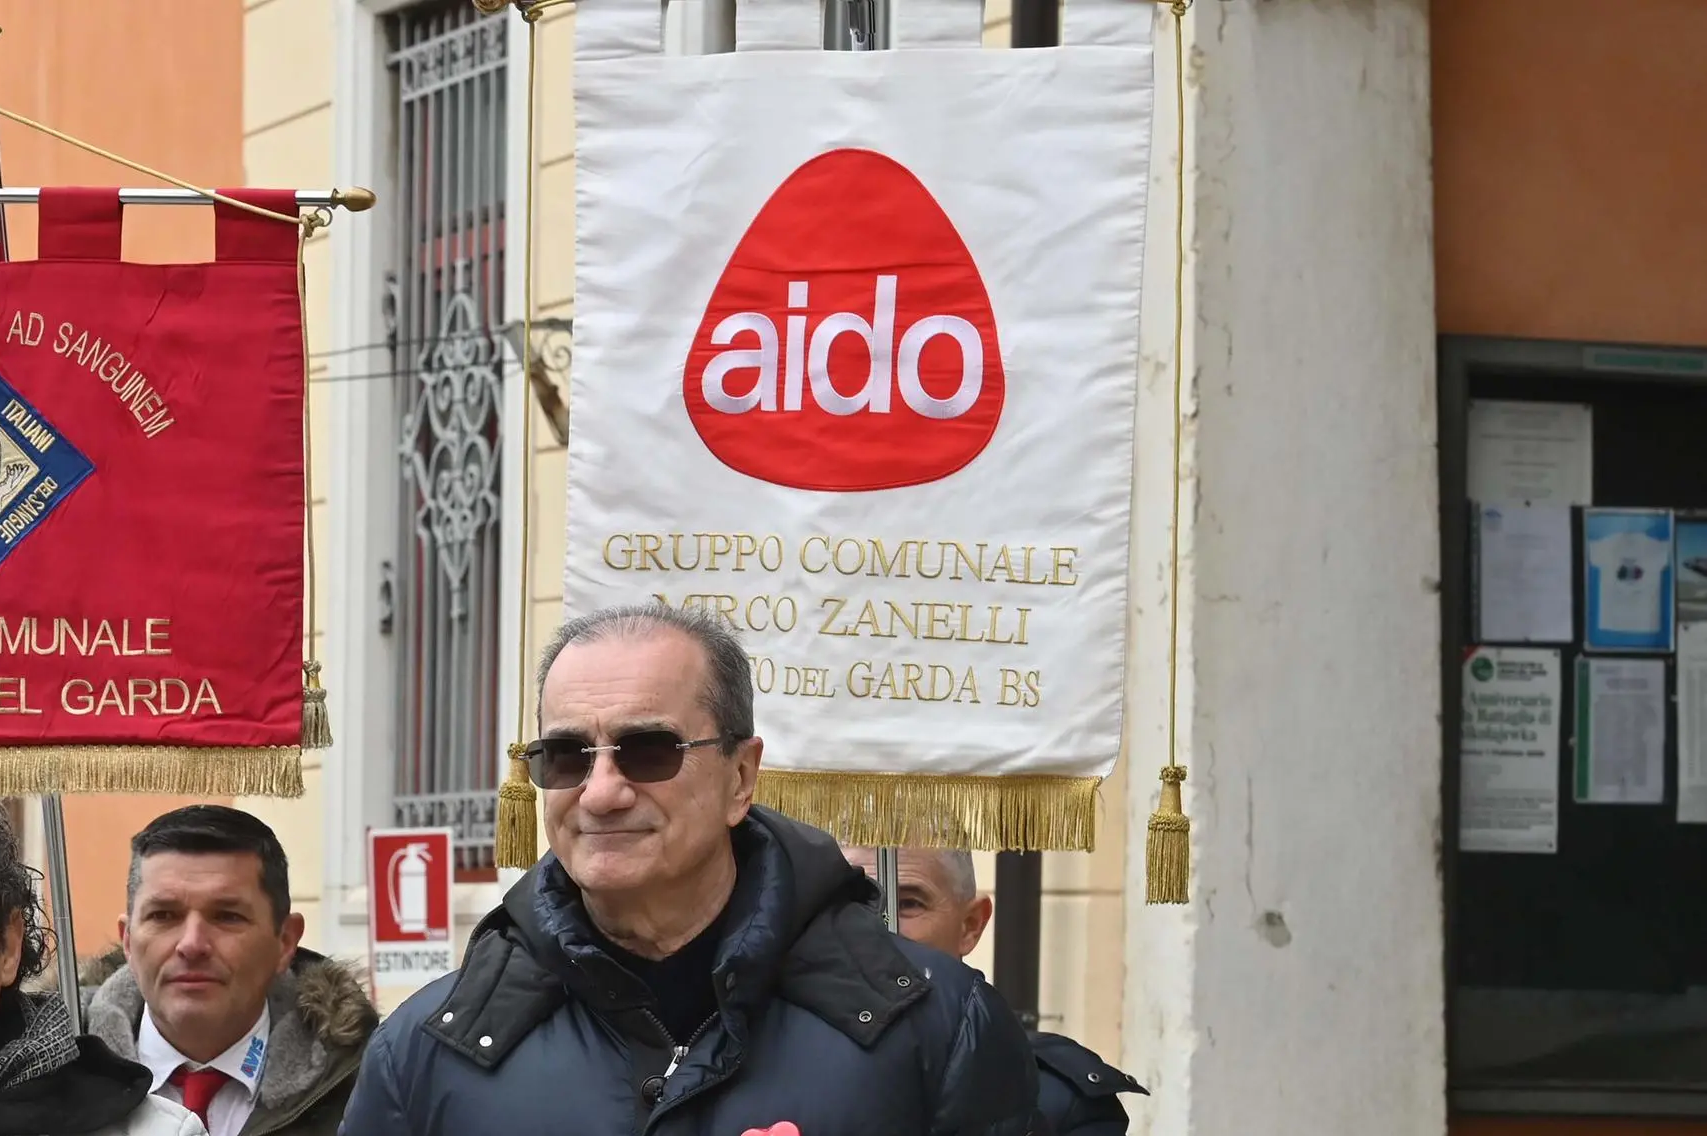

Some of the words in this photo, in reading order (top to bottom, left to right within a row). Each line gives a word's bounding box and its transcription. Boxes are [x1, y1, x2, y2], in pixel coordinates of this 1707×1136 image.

[700, 273, 984, 420] aido
[6, 311, 45, 346] AD
[53, 322, 175, 439] SANGUINEM
[1, 399, 55, 453] ITALIANI
[602, 532, 783, 572] GRUPPO
[799, 535, 1079, 586] COMUNALE
[818, 597, 1033, 645] ZANELLI
[60, 678, 223, 716] GARDA
[783, 665, 836, 698] DEL
[845, 660, 980, 704] GARDA
[996, 667, 1041, 708] BS
[375, 951, 450, 972] ESTINTORE
